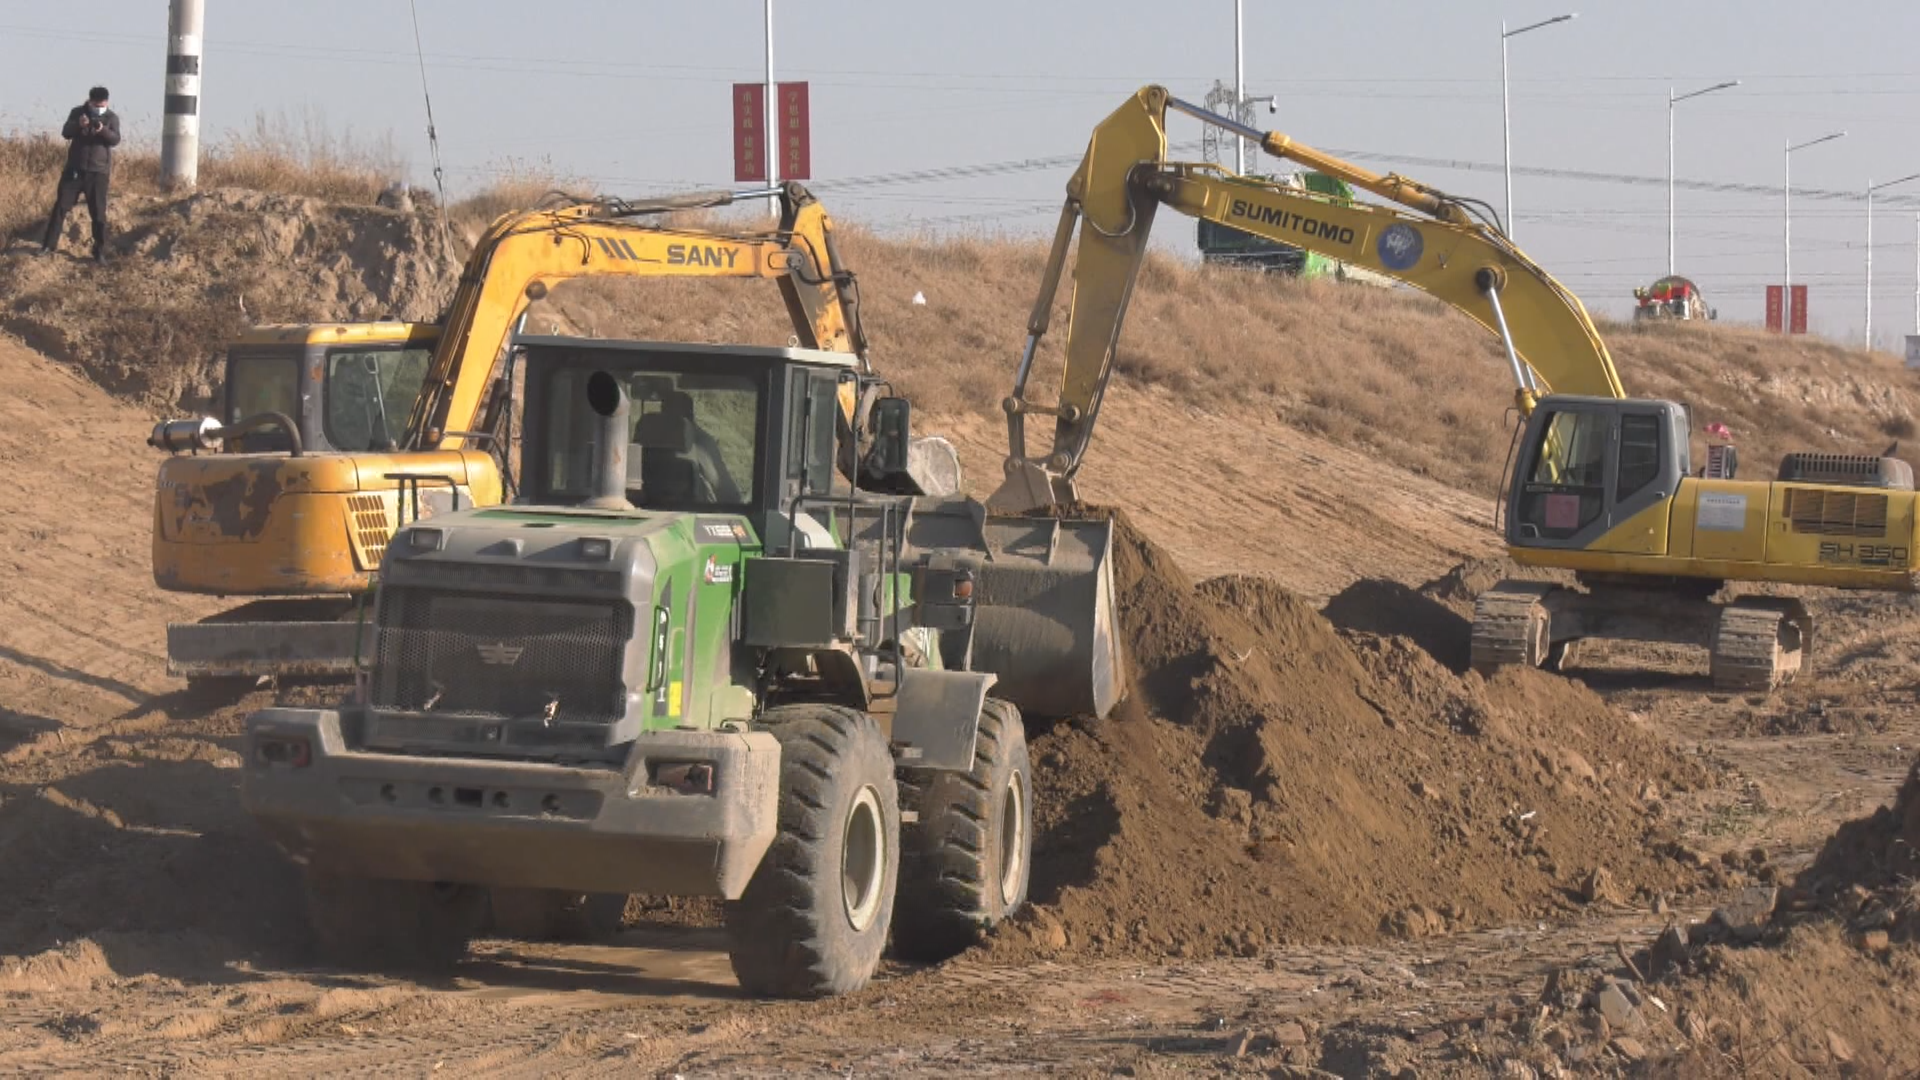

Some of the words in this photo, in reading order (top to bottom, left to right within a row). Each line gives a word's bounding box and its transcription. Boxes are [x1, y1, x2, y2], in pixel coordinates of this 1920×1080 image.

[1231, 199, 1355, 245] SUMITOMO
[667, 245, 739, 268] SANY
[1820, 543, 1854, 557] SH
[1858, 545, 1909, 560] 350
